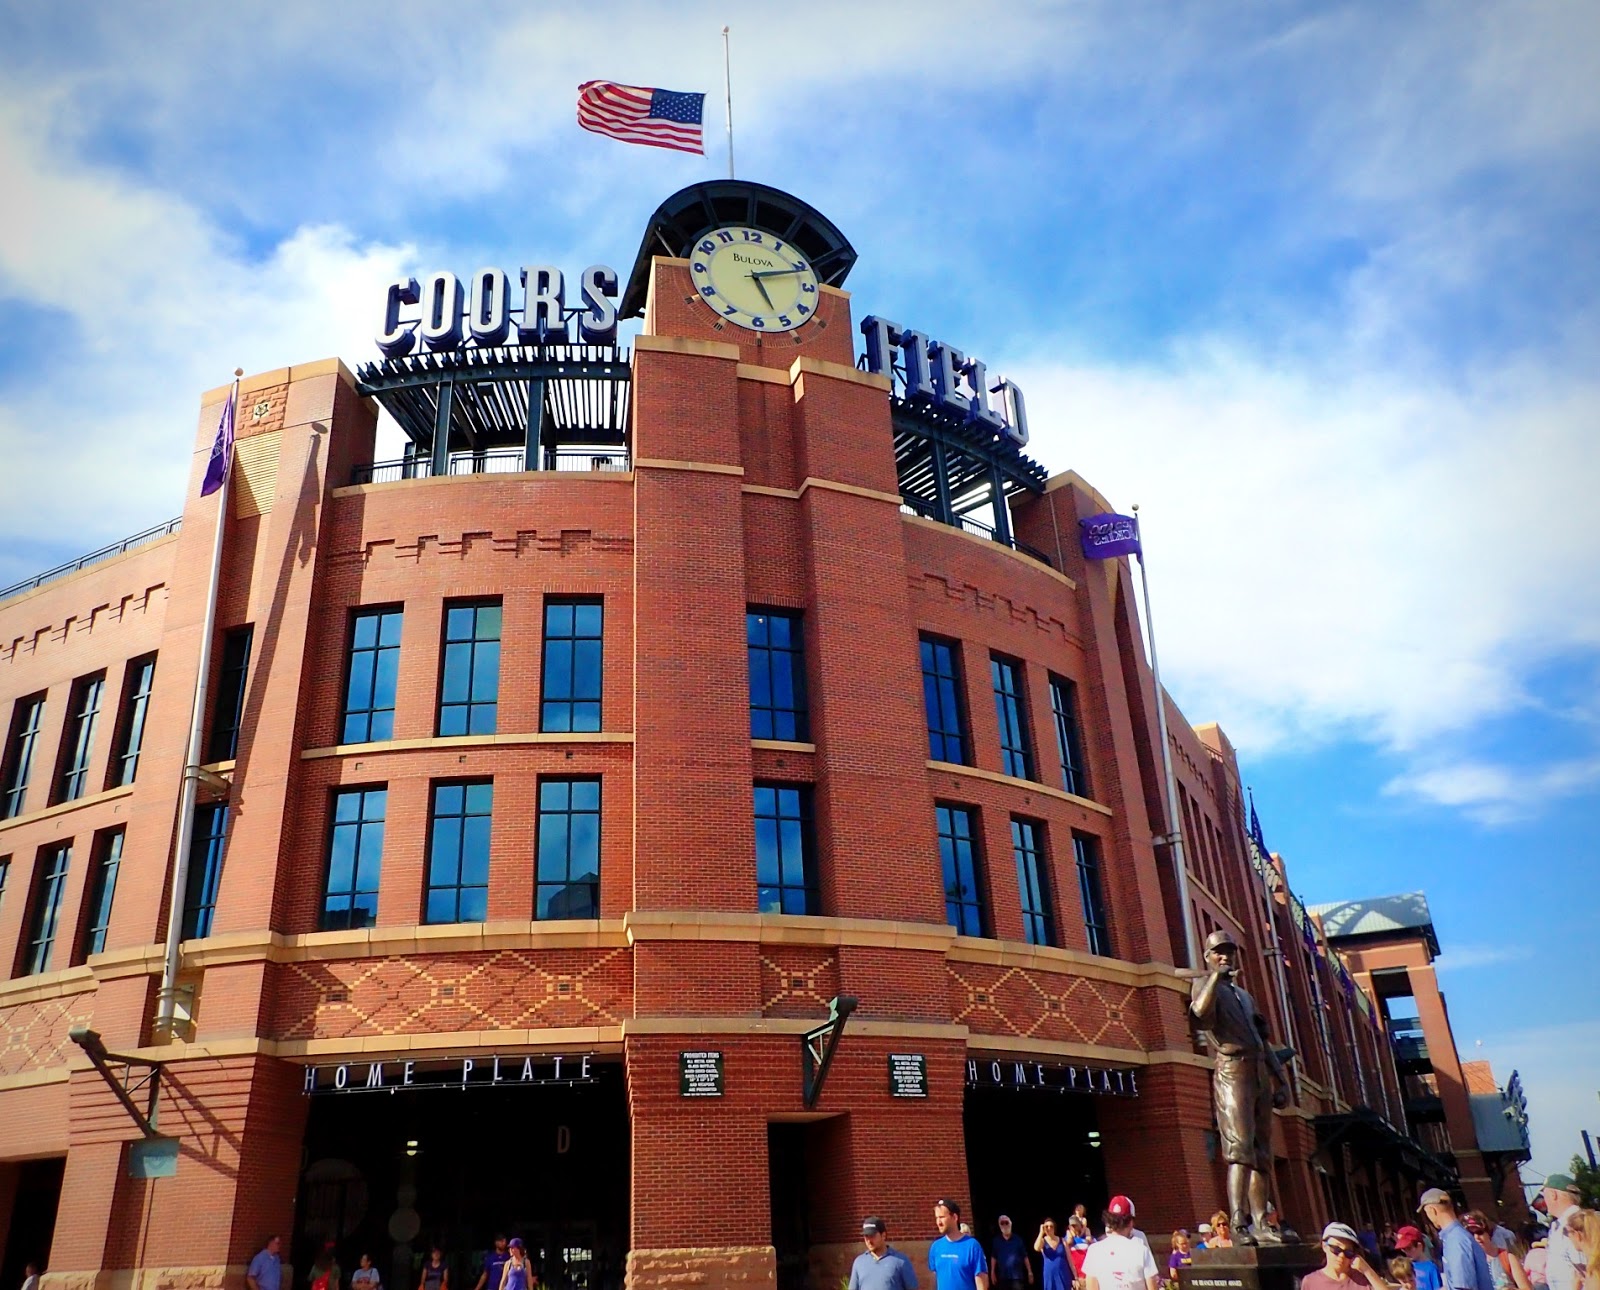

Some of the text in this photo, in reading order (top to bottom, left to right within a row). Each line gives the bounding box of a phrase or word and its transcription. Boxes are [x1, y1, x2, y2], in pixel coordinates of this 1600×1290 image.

[717, 231, 734, 243] 11
[742, 231, 763, 244] 12
[698, 240, 716, 255] 10
[774, 241, 784, 251] 1
[733, 253, 773, 268] BULOVA
[694, 263, 707, 273] 9
[701, 285, 716, 297] 8
[802, 282, 815, 293] 3
[376, 265, 618, 350] COORS
[723, 305, 738, 316] 7
[797, 303, 810, 315] 4
[752, 316, 765, 327] 6
[778, 315, 792, 327] 5
[861, 315, 1029, 447] FIELD
[304, 1055, 592, 1093] HOME PLATE
[968, 1060, 1138, 1093] HOME PLATE
